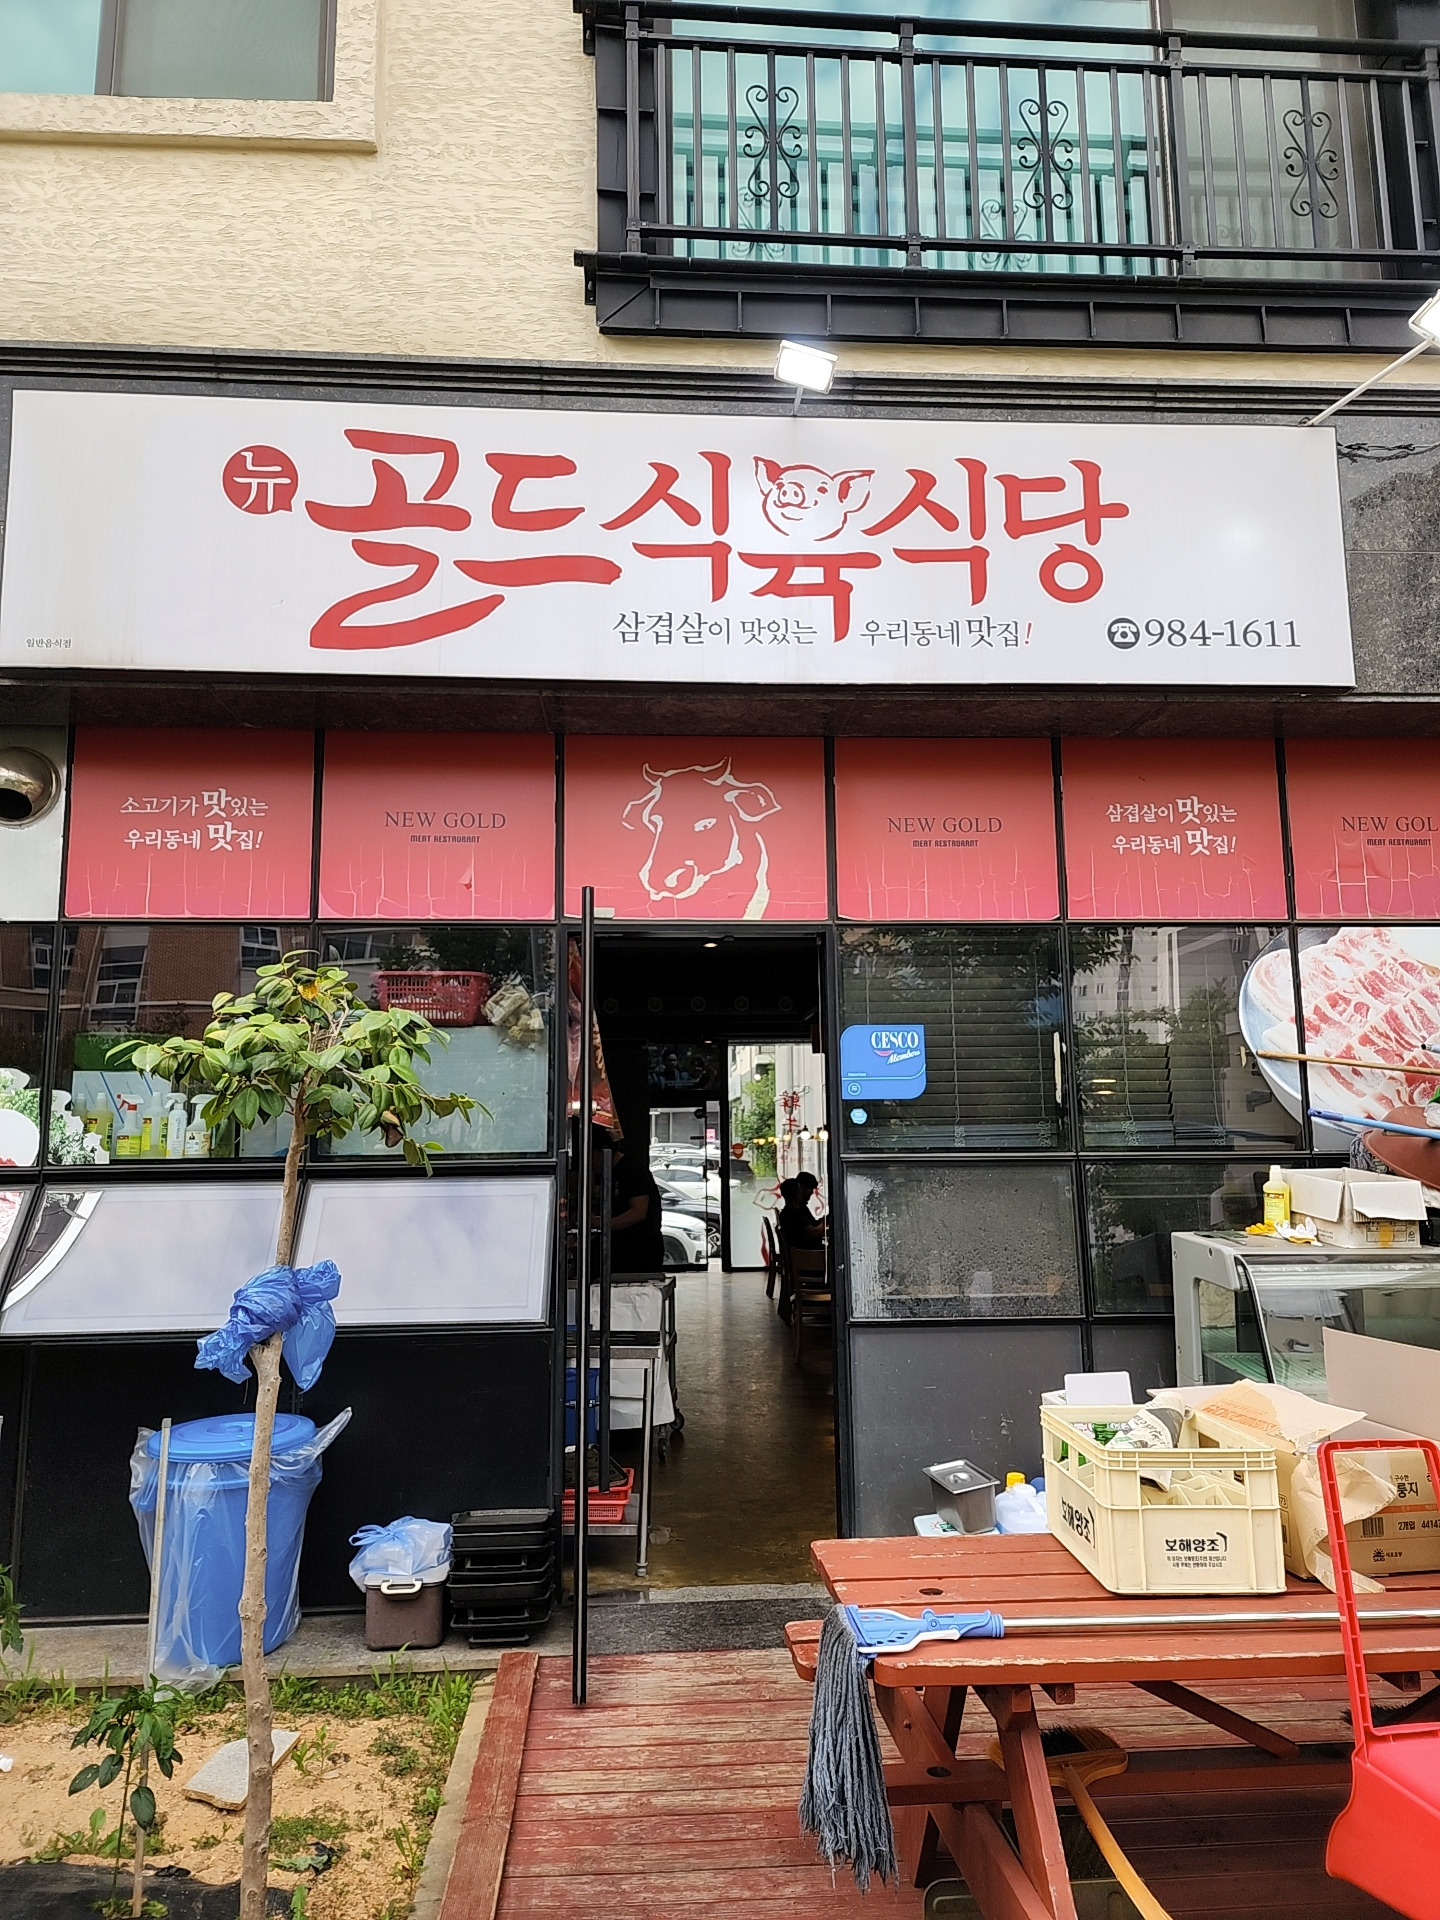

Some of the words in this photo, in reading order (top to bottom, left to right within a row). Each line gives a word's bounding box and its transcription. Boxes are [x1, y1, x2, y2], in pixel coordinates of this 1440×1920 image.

[232, 451, 292, 513] 뉴
[612, 610, 730, 646] 삼겹살이
[739, 617, 818, 646] 맛있는
[859, 618, 960, 647] 우리동네
[965, 615, 1032, 648] 맛집!
[1144, 618, 1302, 648] 984-1611
[26, 637, 72, 649] 일반음식점
[119, 795, 200, 817] 소고기가
[201, 787, 269, 818] 맛있는
[1105, 803, 1174, 824] 삼겹살이
[1175, 795, 1238, 825] 맛있는
[384, 811, 437, 828] NEW
[443, 812, 507, 829] GOLD
[887, 817, 936, 833] NEW
[942, 817, 1003, 833] GOLD
[1341, 816, 1389, 832] NEW
[1395, 816, 1440, 832] GOL
[123, 828, 201, 850] 우리동네
[206, 820, 264, 852] 맛집!
[410, 835, 431, 843] MEAT
[433, 835, 480, 843] RESTAURANT
[912, 839, 932, 848] MEAT
[934, 839, 979, 848] RESTAURANT
[1111, 835, 1182, 855] 우리동네
[1184, 826, 1237, 856] 맛집!
[1366, 838, 1386, 846] MEAT
[1388, 838, 1432, 847] RESTAURANT
[870, 1031, 919, 1049] CESCO
[1061, 1496, 1092, 1545] 보해양조
[1164, 1538, 1220, 1552] 보해양조
